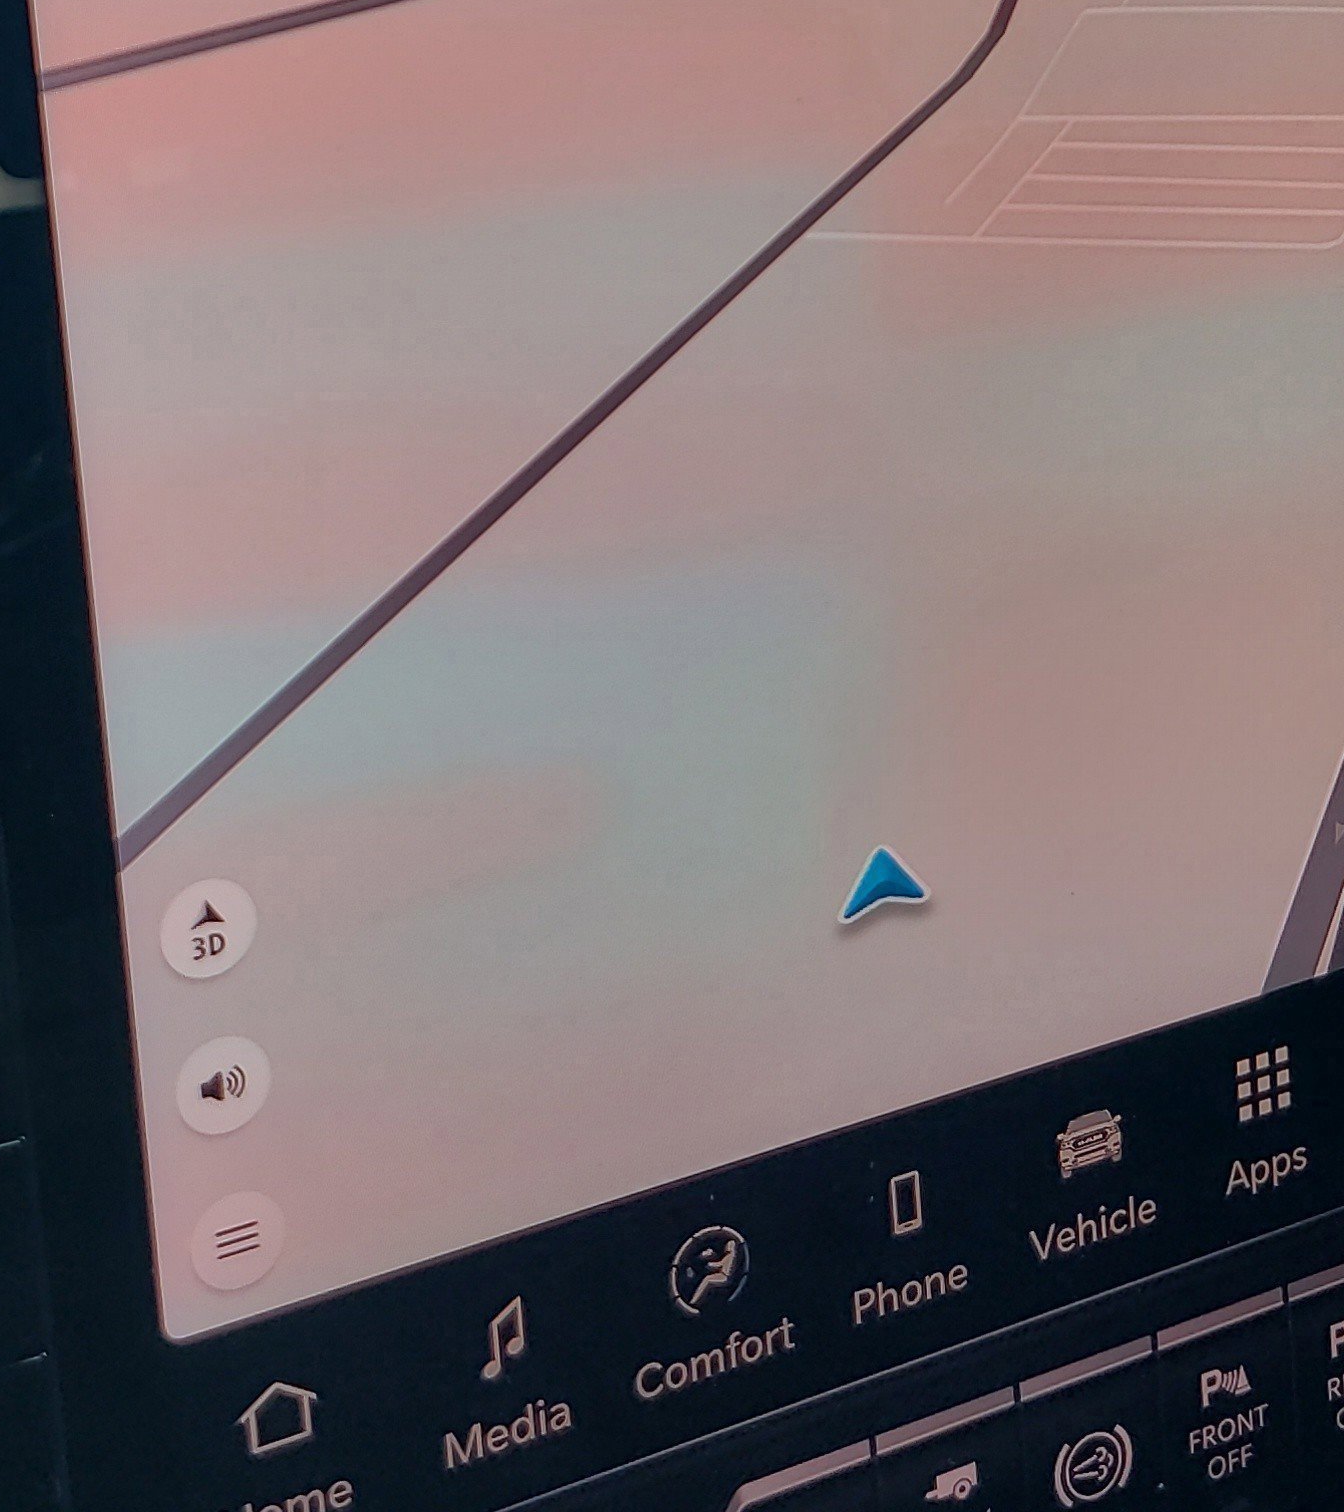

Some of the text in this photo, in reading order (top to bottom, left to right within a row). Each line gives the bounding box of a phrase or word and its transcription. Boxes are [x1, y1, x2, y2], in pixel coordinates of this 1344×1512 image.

[190, 932, 226, 961] 3D
[1225, 1144, 1308, 1197] Apps
[1029, 1195, 1158, 1261] Vehicle
[854, 1263, 969, 1325] Phone
[635, 1317, 795, 1400] Comfort
[443, 1398, 573, 1470] Media
[1188, 1402, 1269, 1455] FRONT
[1207, 1443, 1254, 1481] OFF
